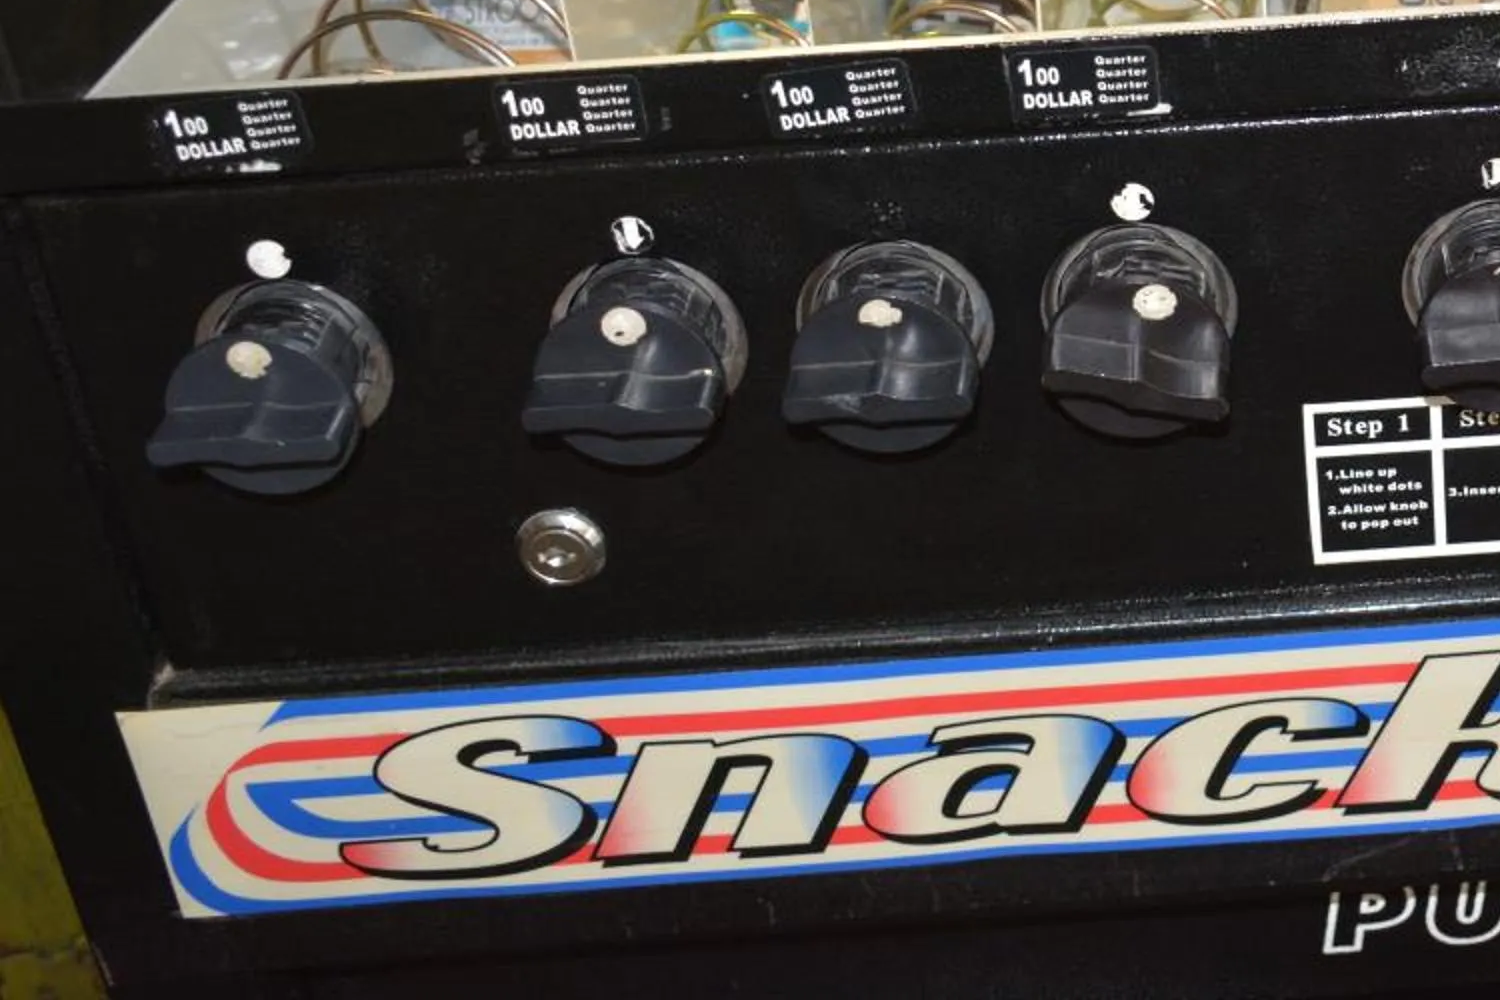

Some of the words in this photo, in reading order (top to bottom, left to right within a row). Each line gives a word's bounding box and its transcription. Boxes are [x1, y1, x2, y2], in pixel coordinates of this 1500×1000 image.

[1094, 55, 1147, 66] Quarter
[845, 67, 896, 81] Quarter
[1096, 68, 1148, 78] Quarter
[576, 84, 628, 95] Quarter
[848, 80, 899, 94] Quarter
[1097, 81, 1149, 91] Quarter
[579, 97, 631, 108] Quarter
[851, 92, 903, 106] Quarter
[1023, 89, 1093, 109] DOLLAR
[1098, 93, 1150, 104] Quarter
[237, 99, 288, 112] Quarter
[855, 105, 906, 119] Quarter
[241, 112, 292, 125] Quarter
[582, 109, 633, 120] Quarter
[779, 106, 851, 131] DOLLAR
[246, 124, 297, 137] Quarter
[510, 119, 581, 141] DOLLAR
[585, 122, 636, 133] Quarter
[175, 137, 247, 162] DOLLAR
[250, 137, 301, 150] Quarter
[1327, 416, 1384, 438] Step
[1398, 413, 1410, 433] 1
[1379, 467, 1398, 480] up
[1339, 481, 1384, 495] white
[1387, 480, 1423, 493] dots
[1327, 502, 1387, 516] 2.Allow
[1389, 500, 1429, 513] knob
[1341, 519, 1358, 531] to
[1361, 518, 1389, 532] pop
[1393, 515, 1419, 527] out
